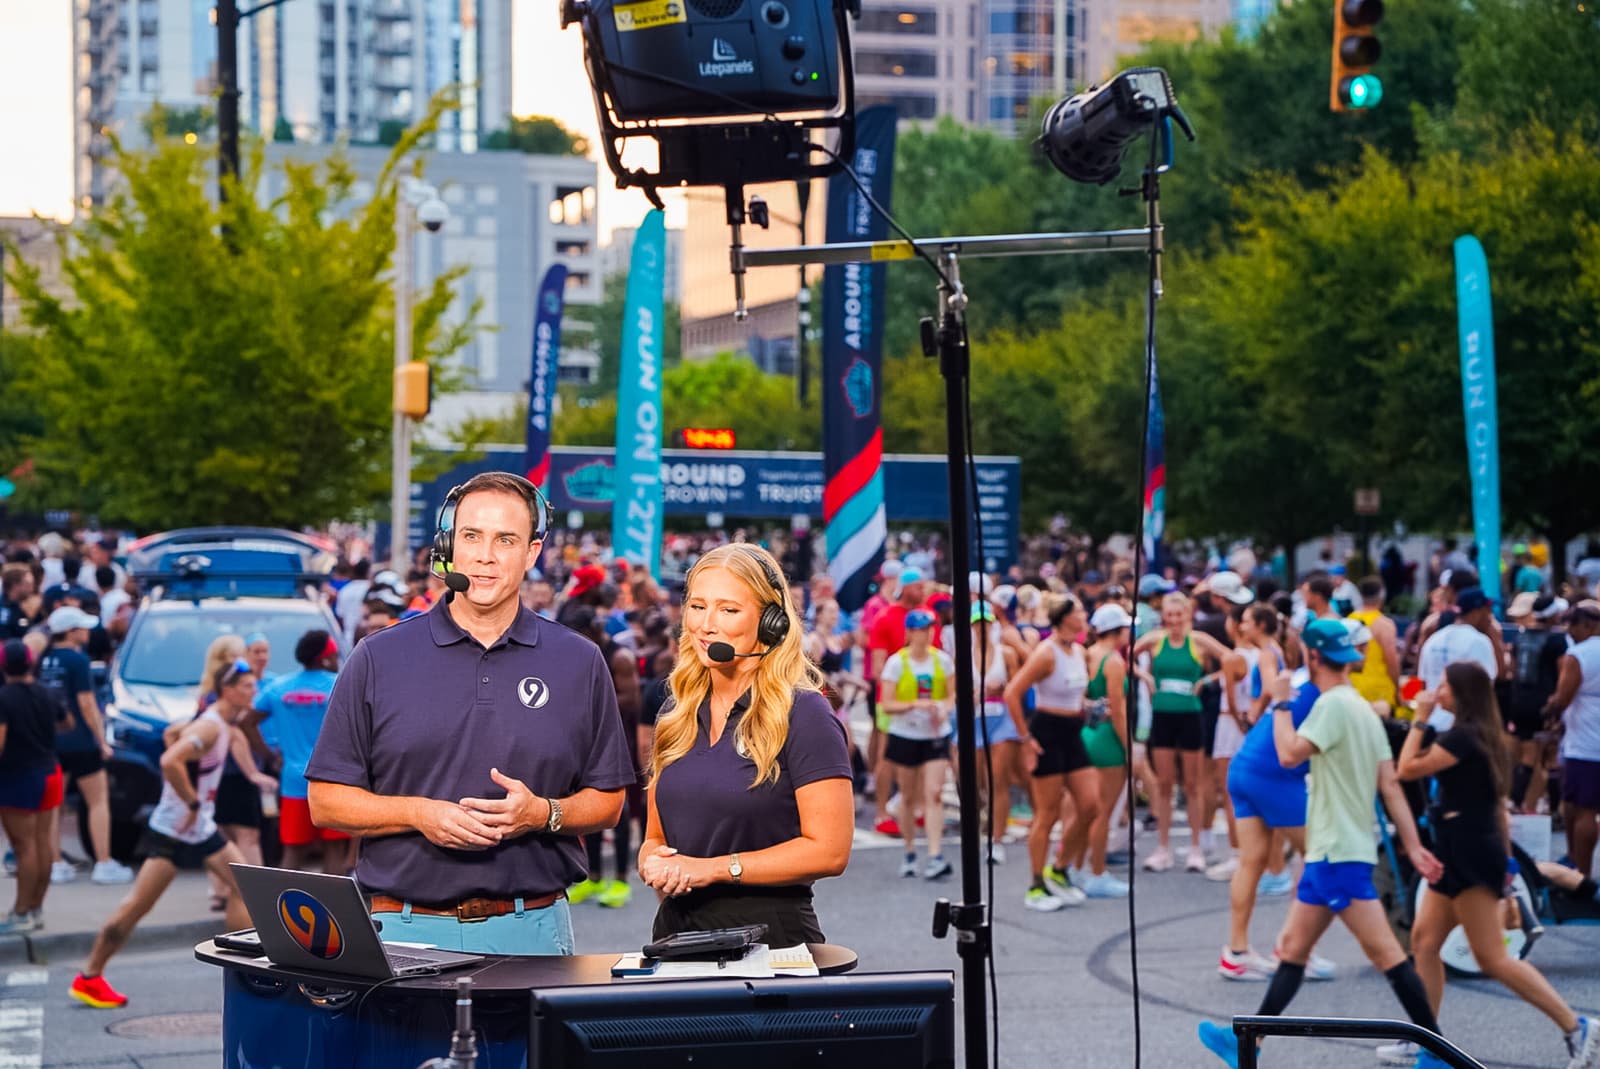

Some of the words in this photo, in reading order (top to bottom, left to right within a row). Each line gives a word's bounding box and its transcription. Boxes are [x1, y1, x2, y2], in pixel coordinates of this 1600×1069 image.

[699, 60, 754, 77] Litepanels
[844, 261, 862, 349] AROUN
[638, 306, 657, 391] RUN
[632, 401, 658, 461] ON
[660, 462, 746, 487] ROUND
[661, 485, 728, 504] ROWN
